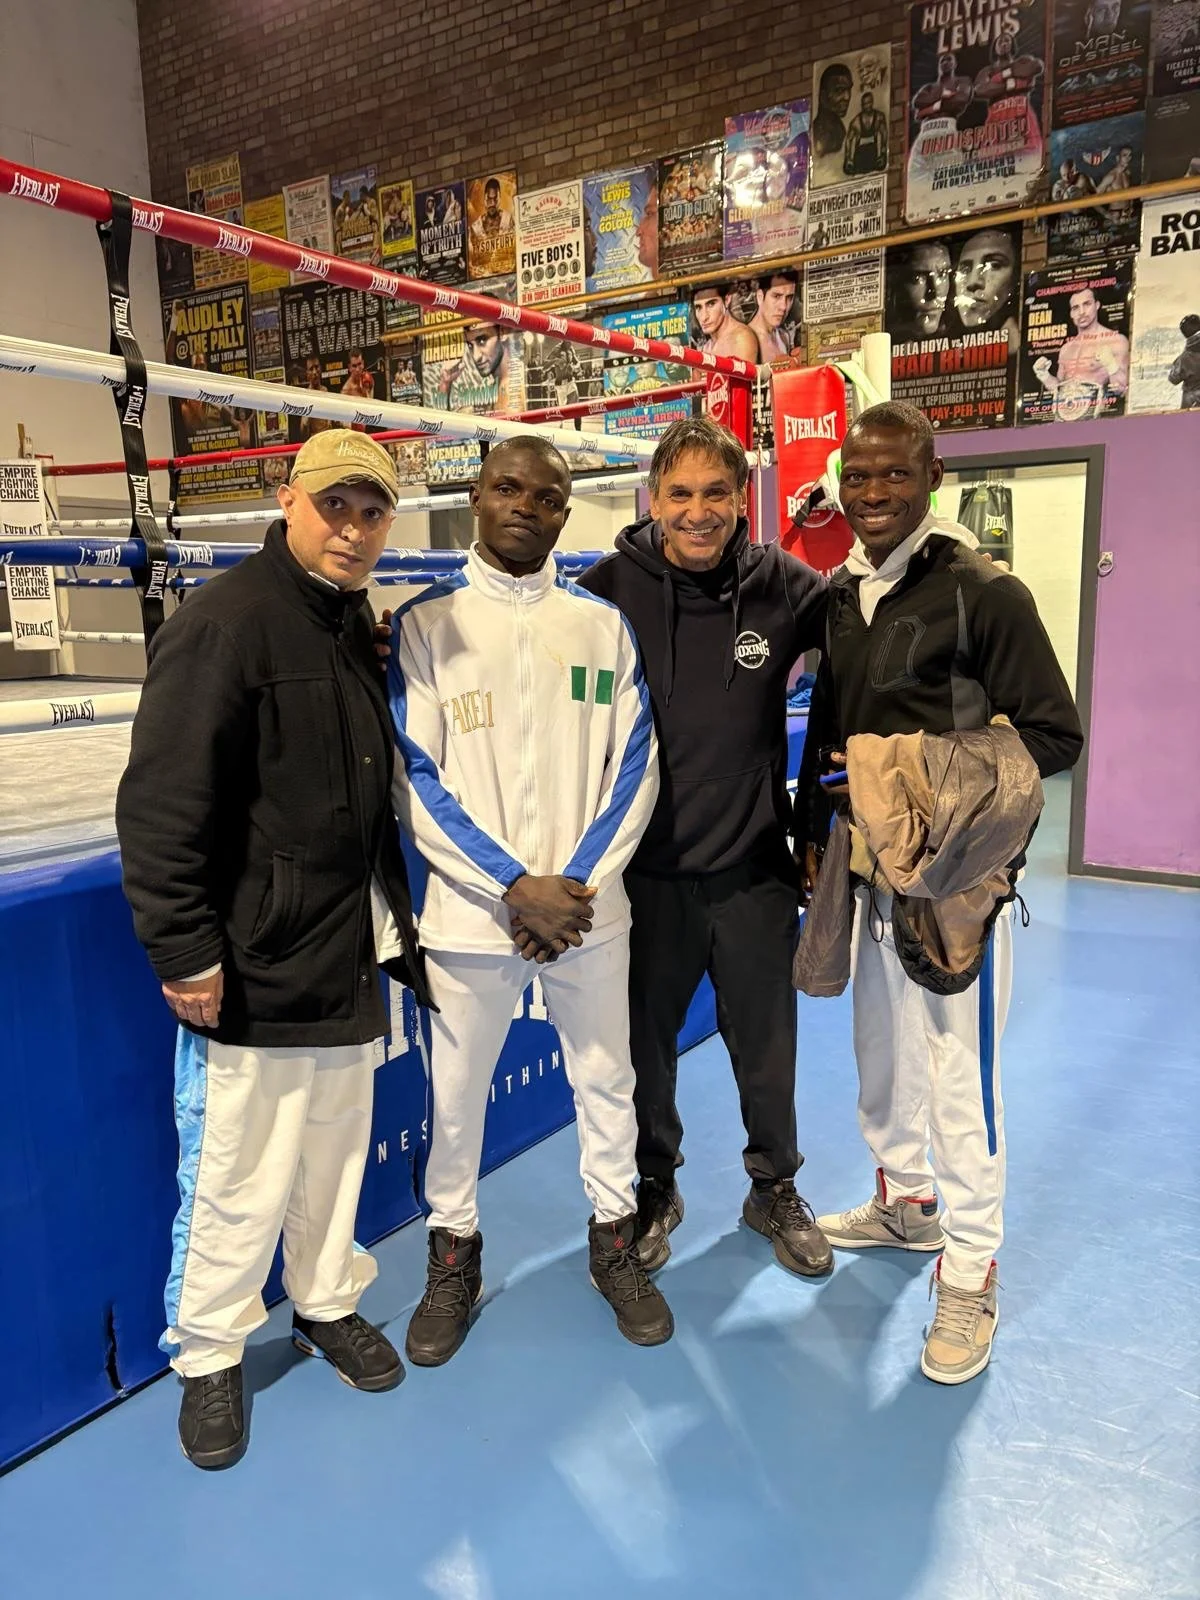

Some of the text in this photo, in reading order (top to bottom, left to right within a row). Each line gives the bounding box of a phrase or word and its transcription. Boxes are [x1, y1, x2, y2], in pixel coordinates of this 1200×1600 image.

[937, 8, 1020, 54] LEWIS
[1075, 29, 1126, 54] MAN
[1085, 40, 1142, 61] STEEL
[932, 166, 1015, 191] LIVE ON PAY-PER-VIEW
[934, 164, 974, 181] SATURDAY
[975, 158, 1006, 171] MARCH
[8, 172, 60, 207] EVERLAST
[602, 187, 631, 203] LEWIS
[663, 198, 717, 222] ROAD TO GLORY
[809, 186, 882, 216] HEAVYWEIGHT EXPLOSION
[599, 218, 633, 233] GOLOTA
[728, 207, 753, 223] GLENN
[859, 217, 881, 234] SMITH
[214, 226, 254, 256] EVERLAST
[420, 221, 462, 241] MOMENT
[421, 234, 462, 256] OF TRUTH
[521, 249, 544, 268] FIVE
[546, 242, 573, 263] BOYS
[297, 251, 331, 279] EVERLAST
[368, 272, 398, 297] EVERLAST
[1036, 282, 1089, 297] CHAMPIONSHIP
[1089, 277, 1117, 288] BOXING
[432, 288, 459, 309] EVERLAST
[110, 293, 135, 340] EVERLAST
[177, 297, 244, 336] AUDLEY
[285, 290, 379, 331] HASKINS
[1028, 310, 1053, 327] DEAN
[637, 323, 646, 338] OF
[647, 321, 661, 338] THE
[662, 316, 687, 335] TIGERS
[1027, 323, 1068, 342] FRANCIS
[187, 332, 208, 356] THE
[210, 325, 245, 351] PALLY
[287, 317, 380, 360] VS WARD
[892, 343, 905, 358] DE
[906, 341, 919, 356] LA
[920, 337, 949, 355] HOYA
[962, 328, 1009, 350] VARGAS
[1031, 339, 1064, 349] Thursday
[210, 353, 220, 363] SAT
[234, 348, 247, 358] JUNE
[892, 343, 1008, 380] BAD BLOOD
[952, 381, 975, 392] RESORT
[983, 377, 1007, 388] CASINO
[122, 385, 143, 429] EVERLAST
[925, 391, 964, 406] SEPTEMBER
[966, 391, 974, 400] 14
[607, 408, 637, 419] WRIGHT
[651, 403, 688, 414] BINGHAM
[618, 410, 686, 427] NYNEX ARENA
[930, 400, 1006, 421] PAY-PER-VIEW
[783, 410, 838, 445] EVERLAST
[428, 444, 481, 461] WEMBLEY
[443, 466, 468, 474] OFFICE
[0, 489, 39, 499] CHANCE
[129, 474, 154, 518] EVERLAST
[3, 523, 42, 535] EVERLAST
[174, 544, 213, 567] EVERLAST
[9, 567, 47, 577] EMPIRE
[10, 577, 49, 587] FIGHTING
[145, 561, 168, 601] EVERLAST
[11, 587, 50, 597] CHANCE
[15, 620, 54, 639] EVERLAST
[50, 699, 95, 726] EVERLAST
